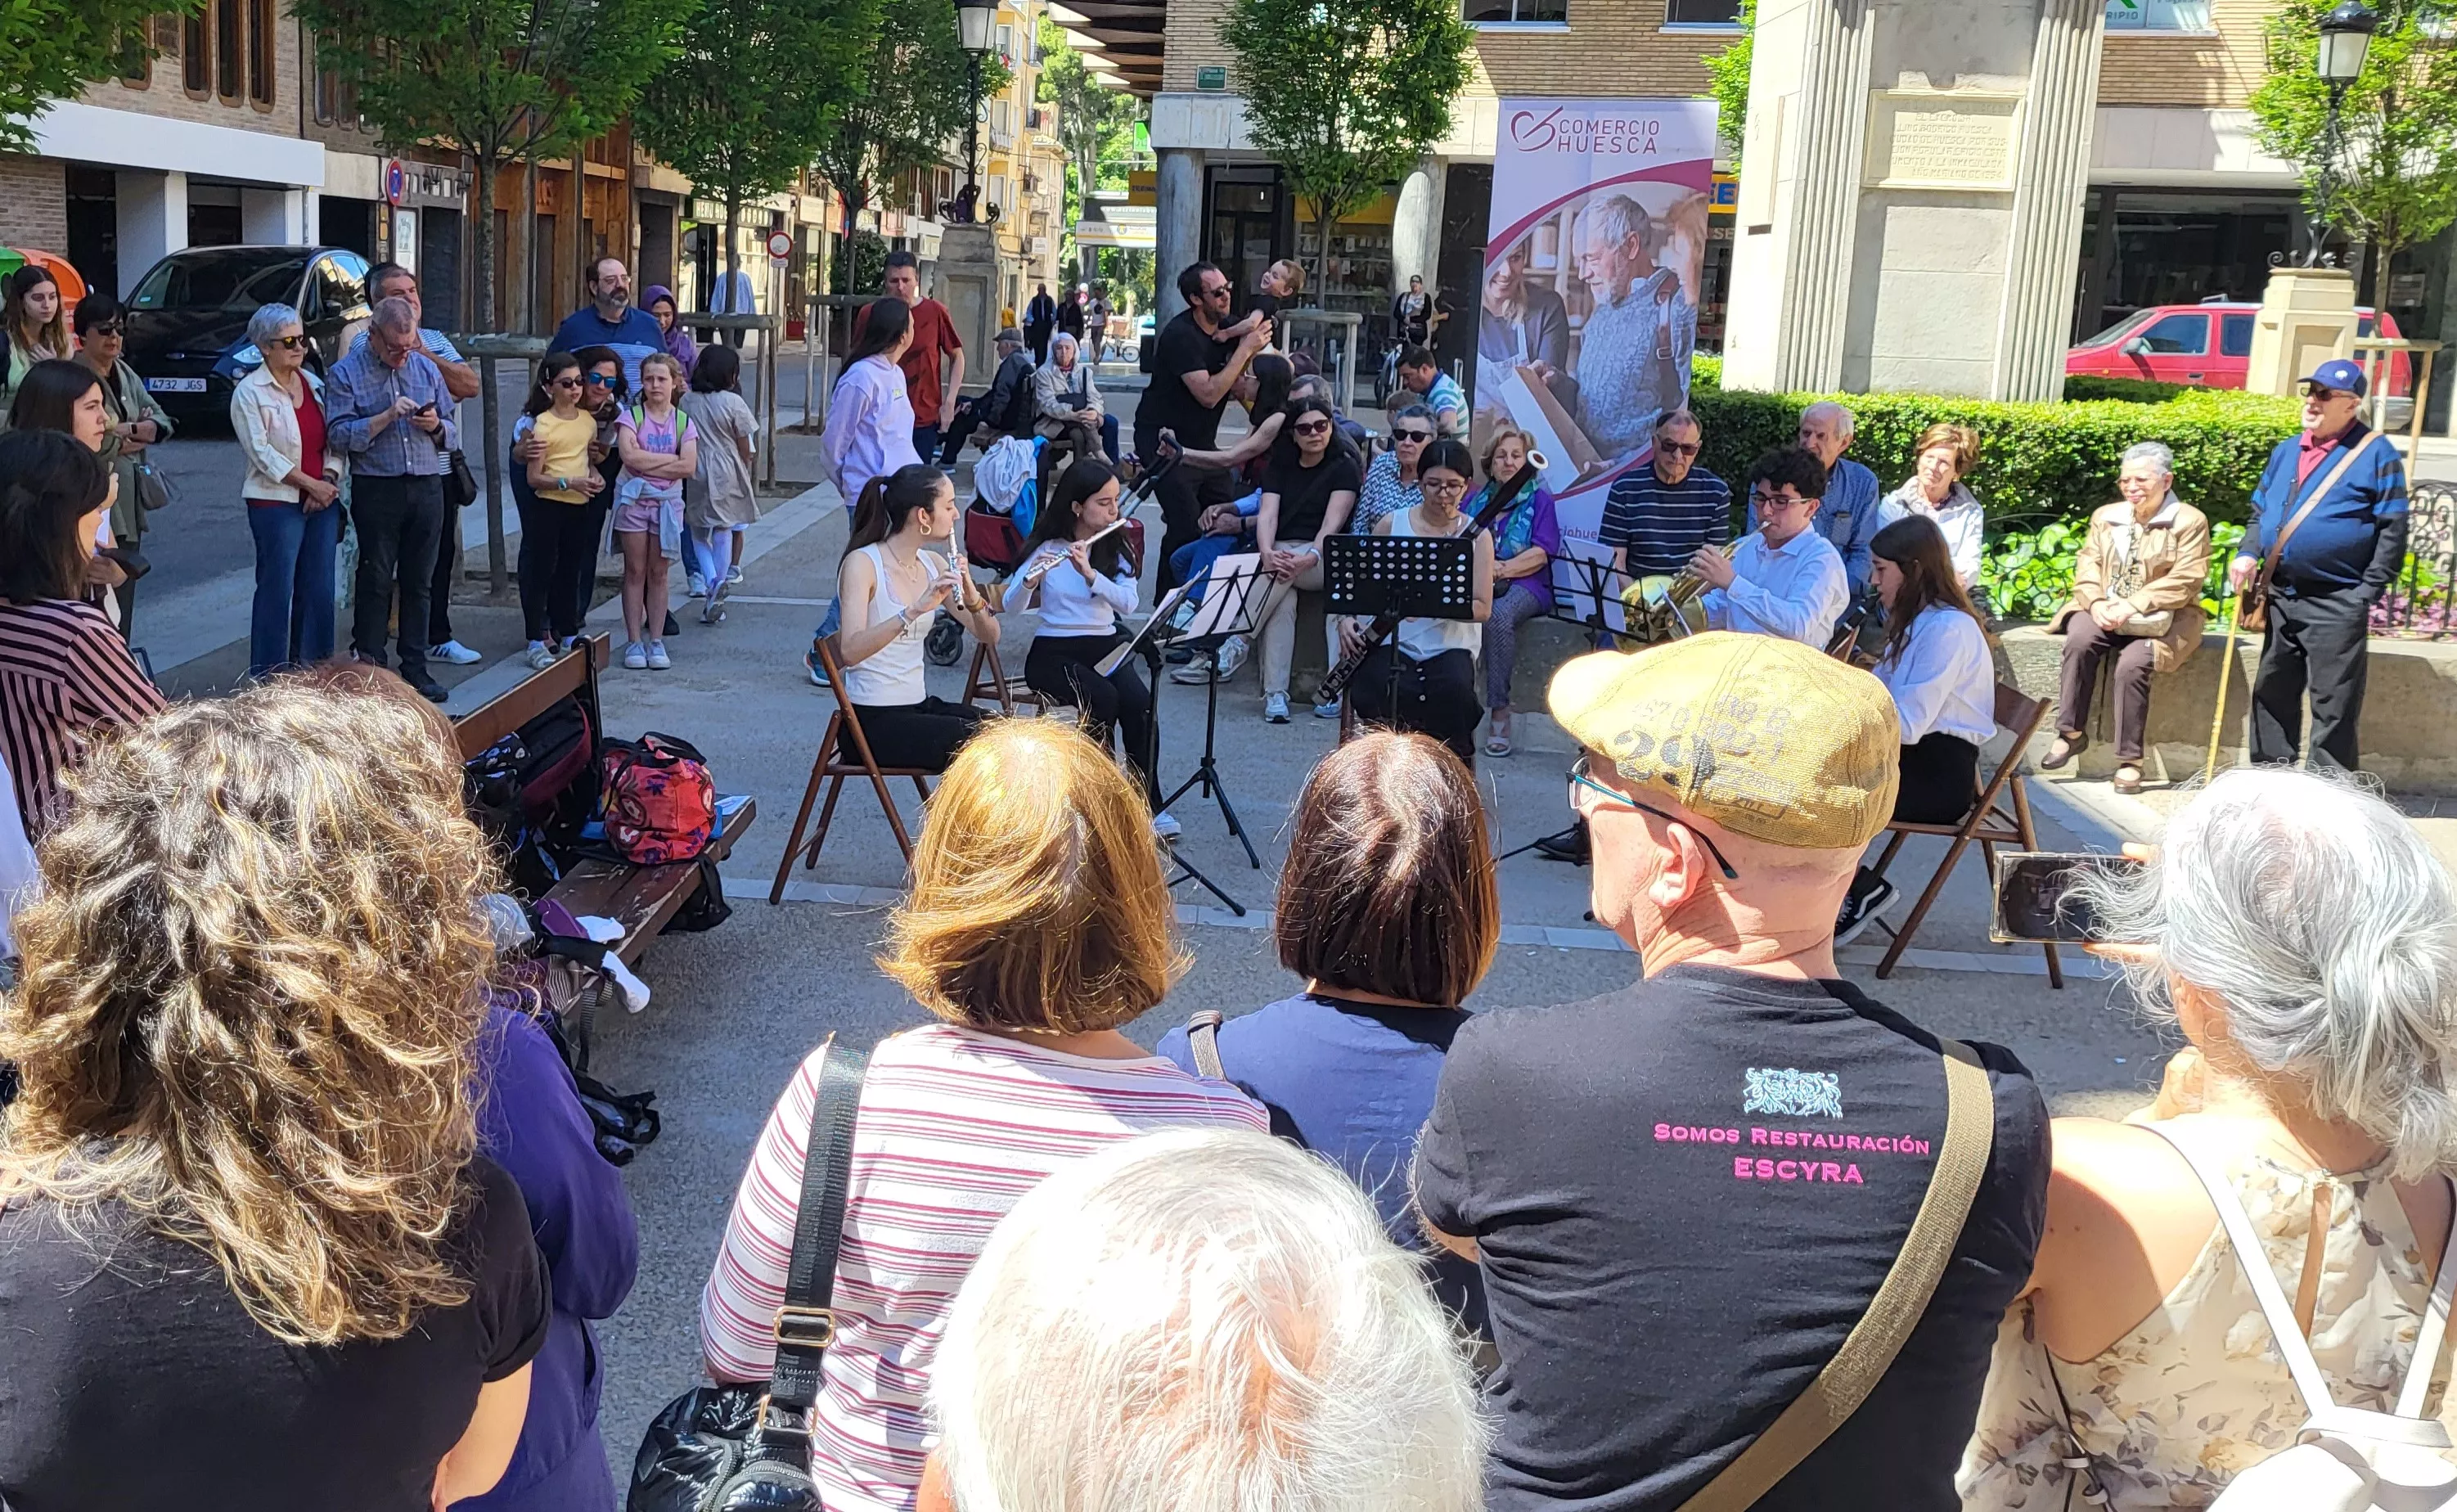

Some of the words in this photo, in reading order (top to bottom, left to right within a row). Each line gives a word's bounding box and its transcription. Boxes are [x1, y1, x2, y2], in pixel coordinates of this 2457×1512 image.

[1559, 119, 1660, 136] COMERCIO
[1557, 135, 1658, 155] HUESCA
[151, 379, 178, 390] 4732
[184, 380, 203, 391] JGS
[1654, 1123, 1741, 1145] SOMOS
[1750, 1127, 1931, 1156] RESTAURACIÓN
[1733, 1155, 1865, 1185] ESCYRA
